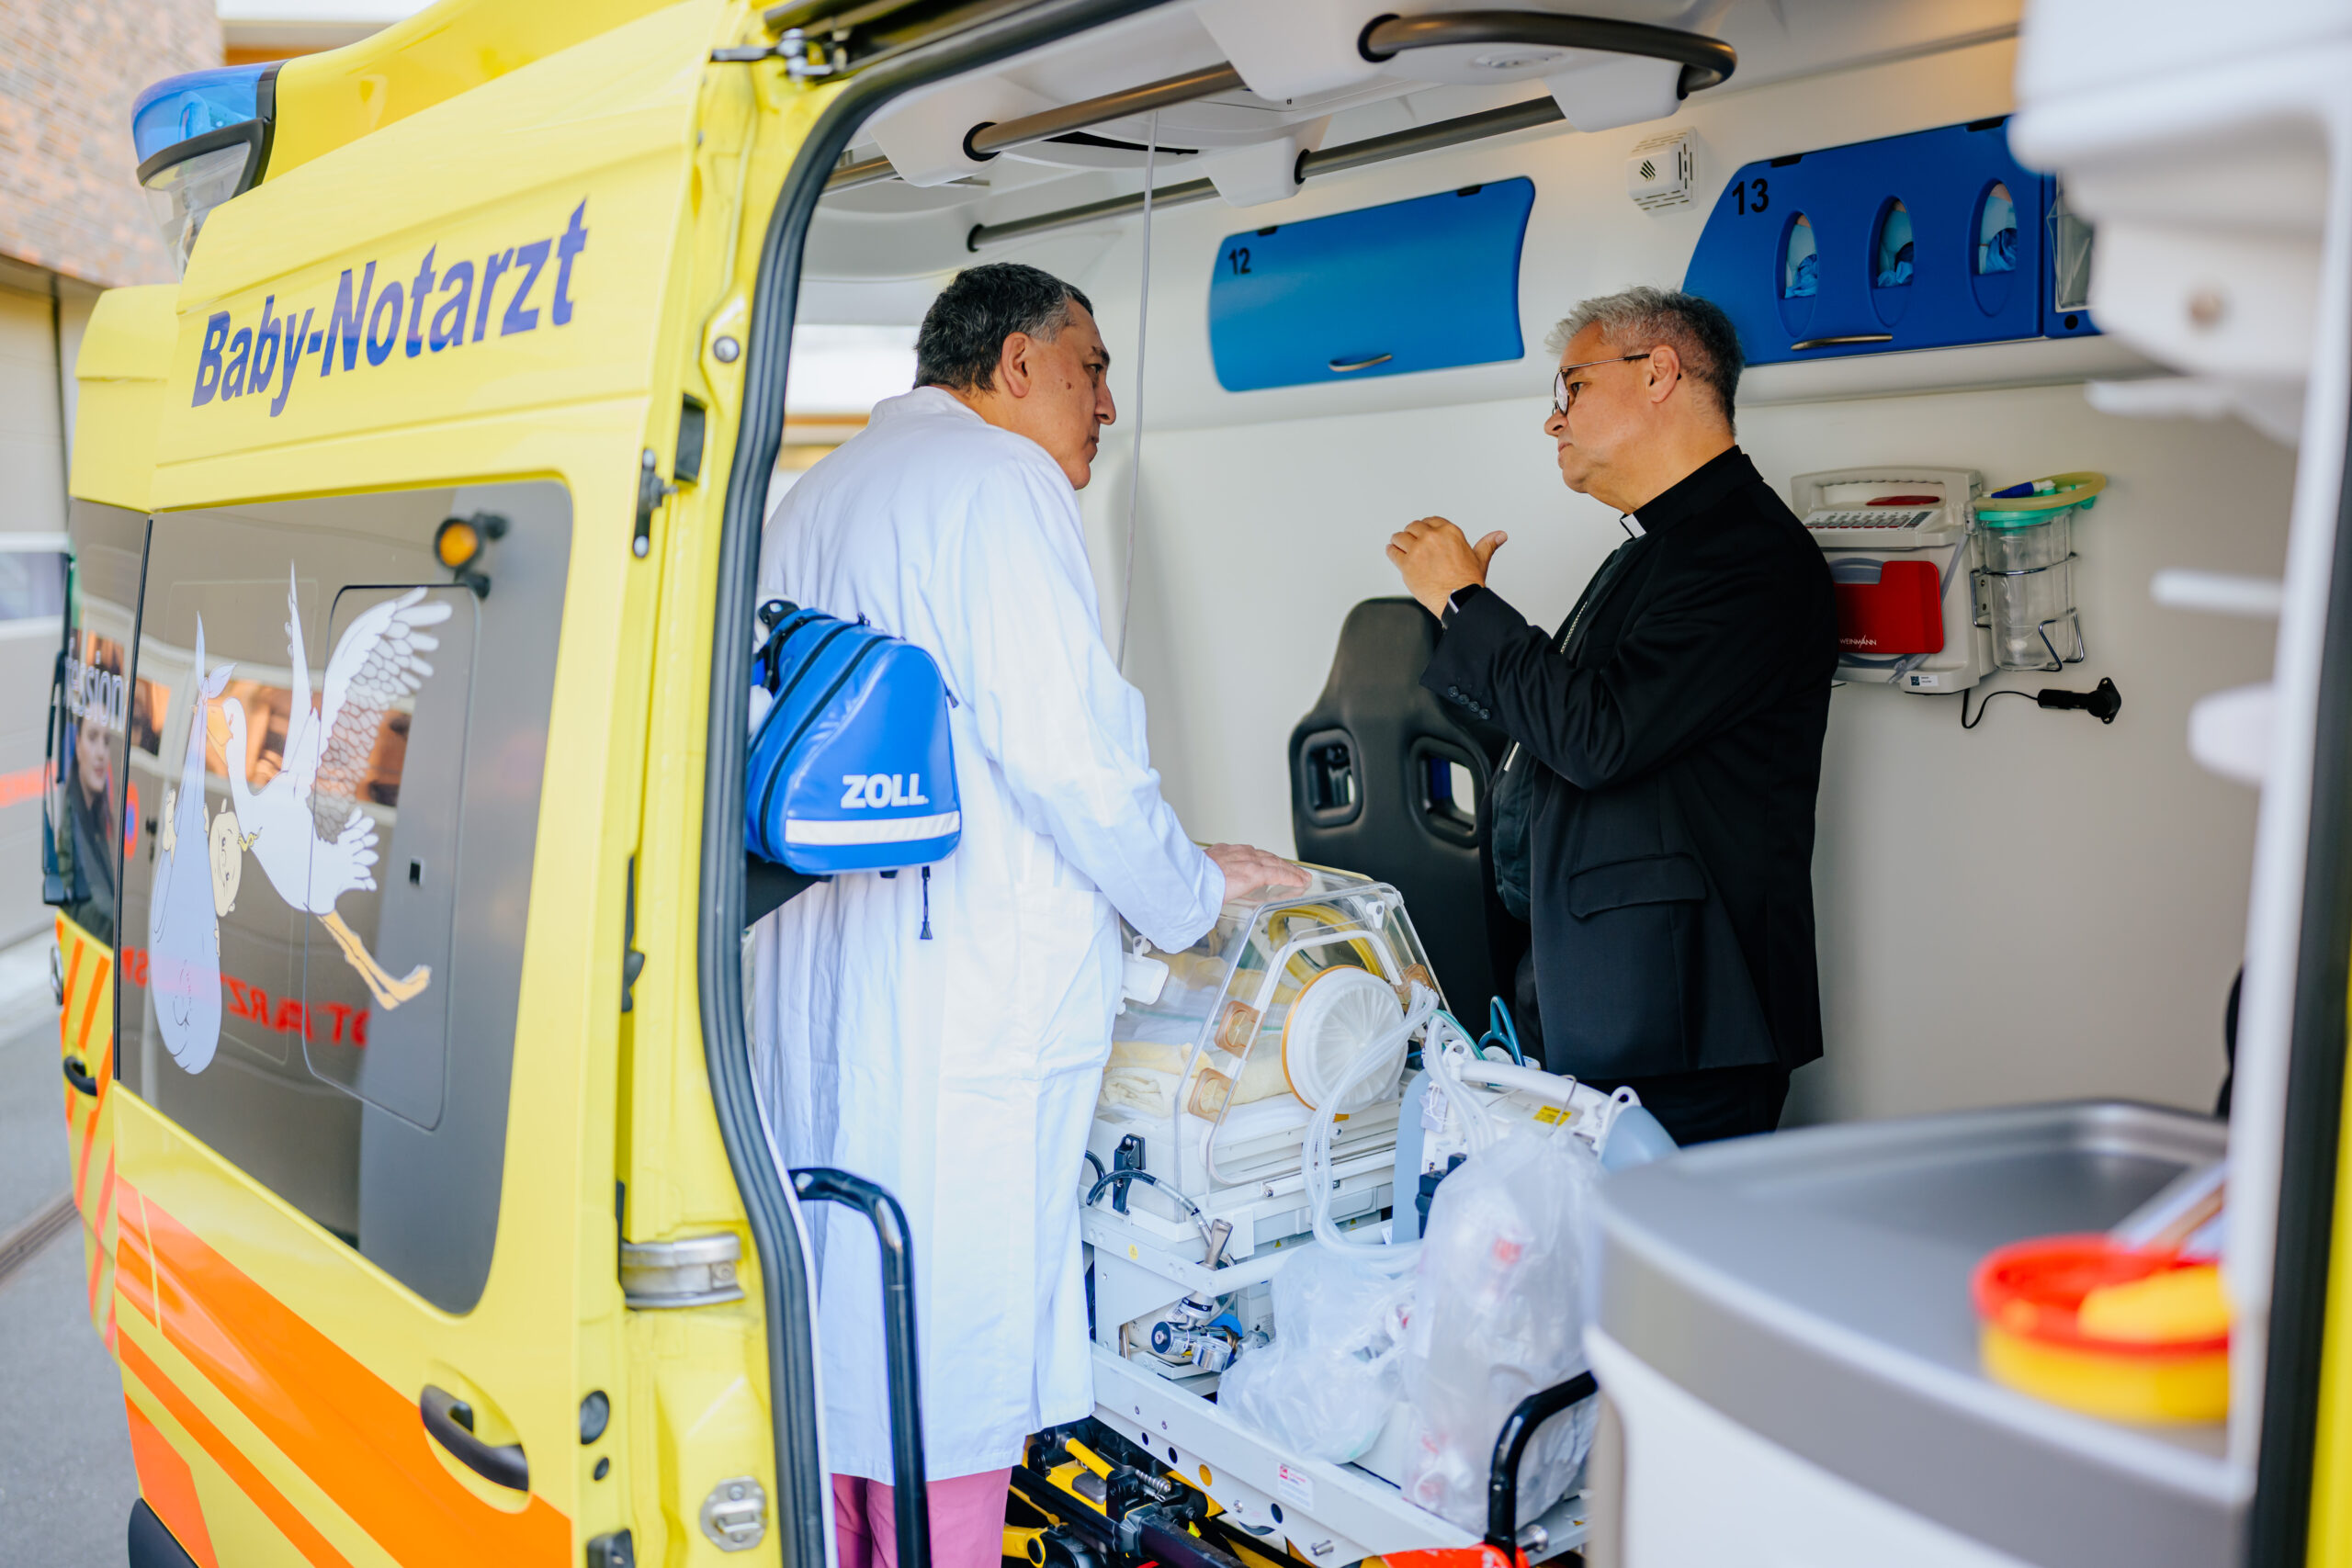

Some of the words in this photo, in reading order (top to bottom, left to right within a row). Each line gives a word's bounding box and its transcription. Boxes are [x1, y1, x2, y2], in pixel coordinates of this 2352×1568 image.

[1732, 178, 1769, 215] 13
[1228, 247, 1251, 275] 12
[191, 196, 589, 418] Baby-Notarzt
[1839, 634, 1877, 649] WEINMANN
[841, 773, 929, 808] ZOLL
